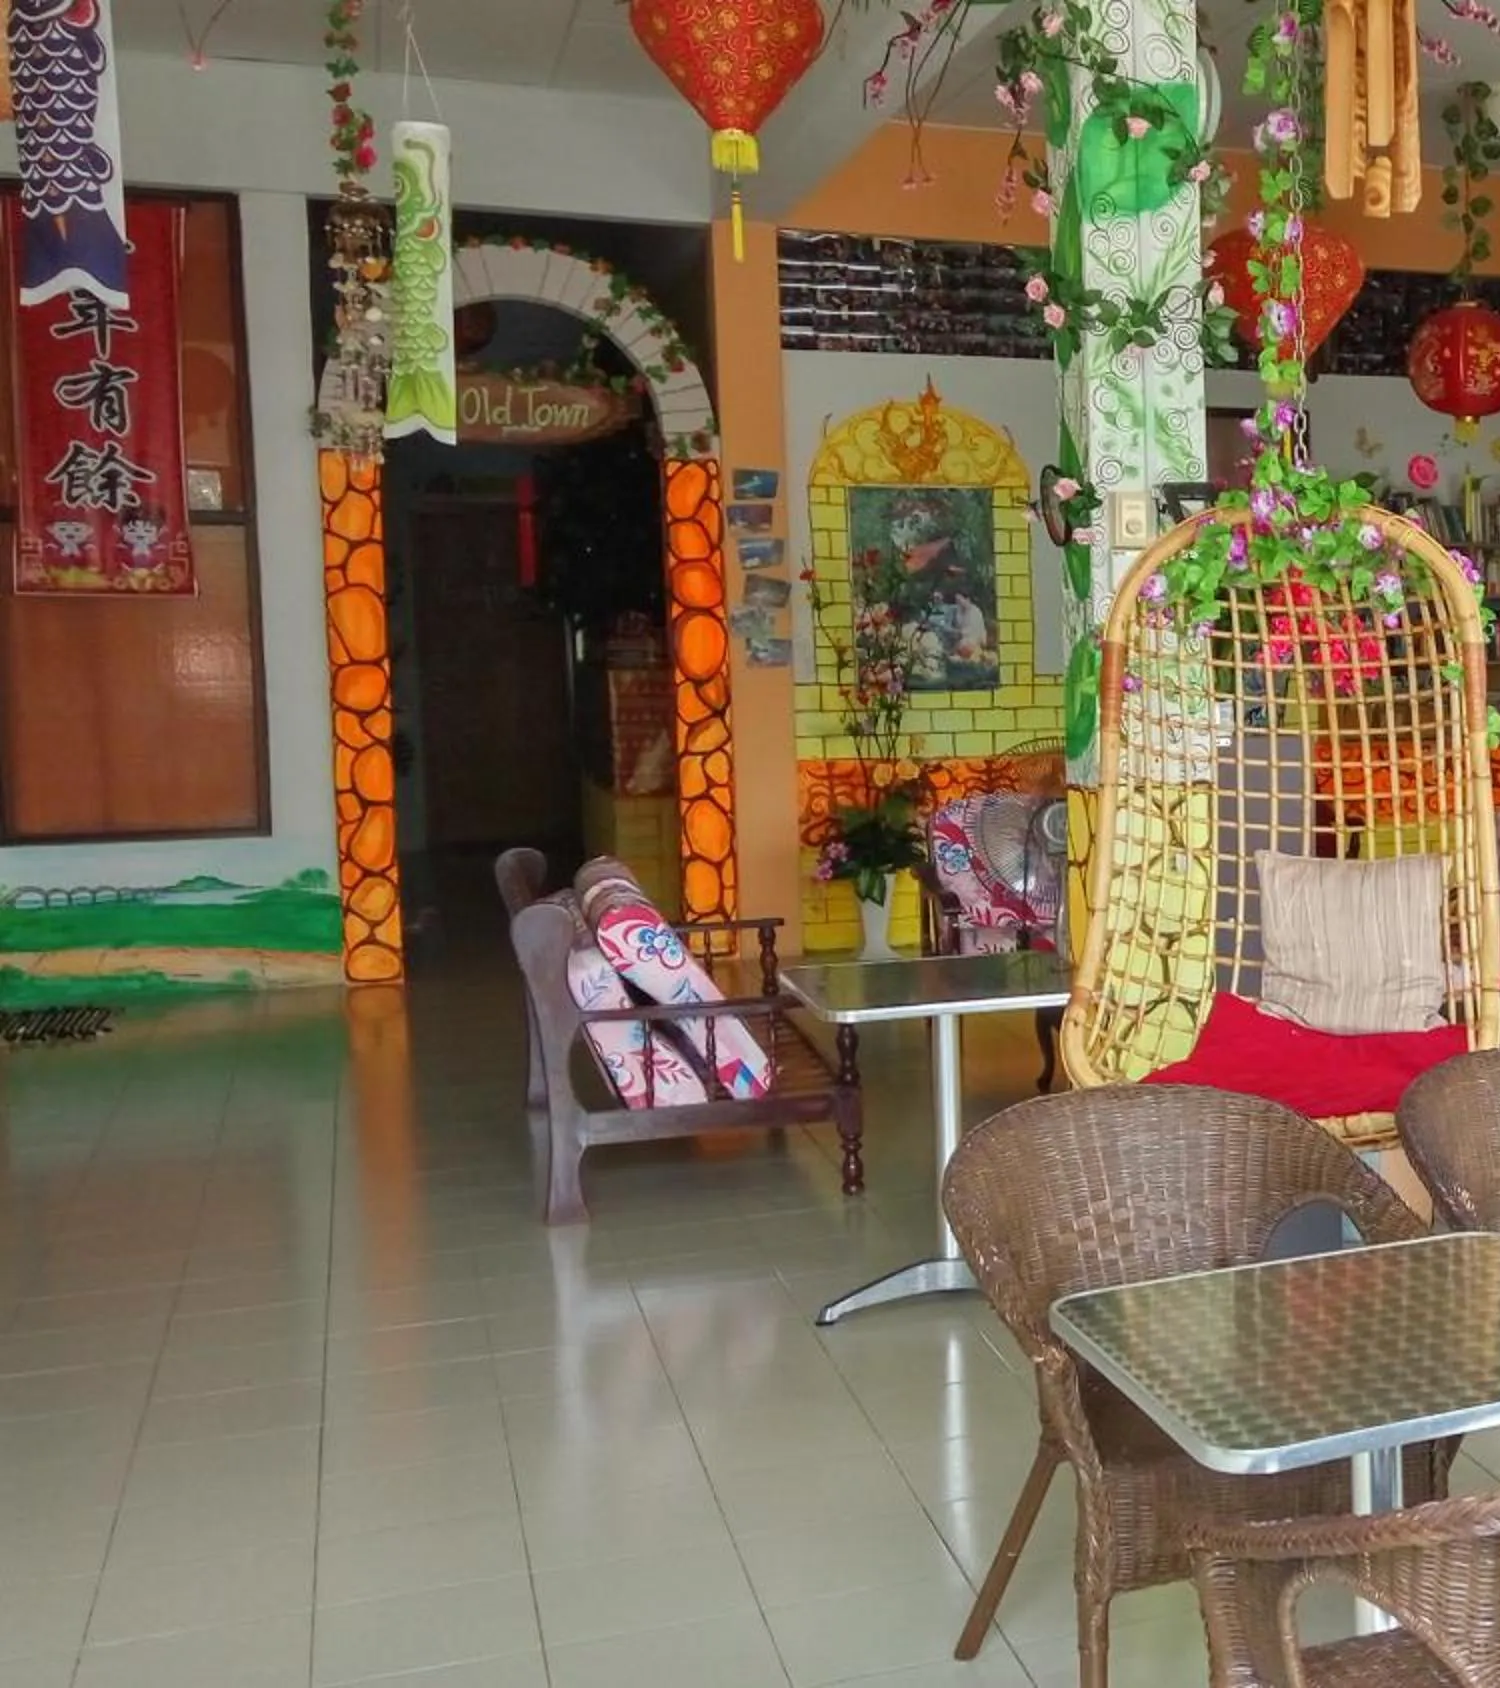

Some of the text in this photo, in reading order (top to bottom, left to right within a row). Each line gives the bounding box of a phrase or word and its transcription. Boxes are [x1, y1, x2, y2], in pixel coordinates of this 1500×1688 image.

[46, 240, 155, 514] 年有餘
[462, 385, 589, 428] Old Town
